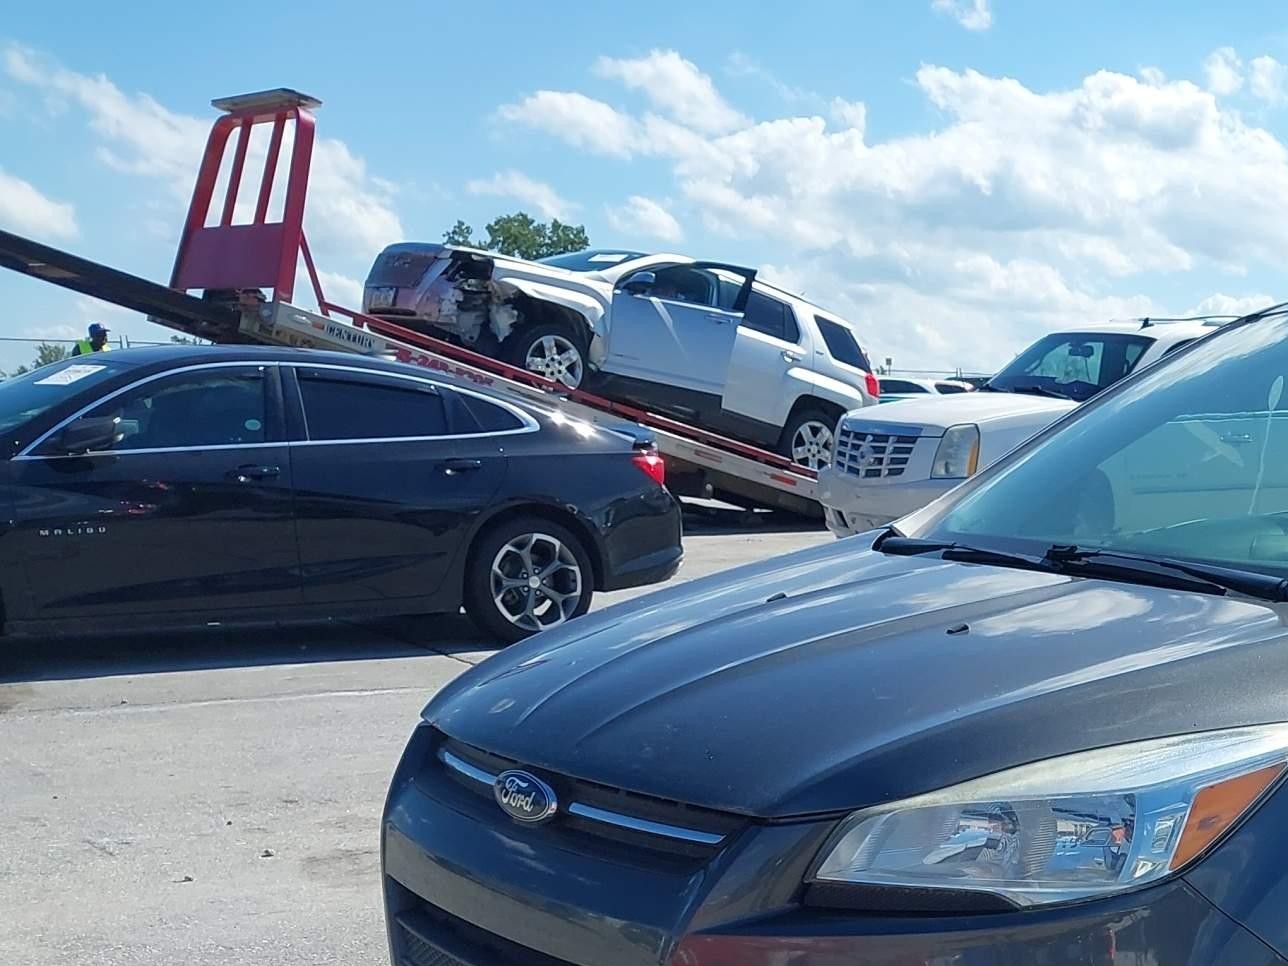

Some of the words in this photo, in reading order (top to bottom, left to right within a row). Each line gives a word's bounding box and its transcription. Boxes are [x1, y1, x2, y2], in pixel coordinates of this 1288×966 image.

[326, 323, 375, 349] CENTURY
[39, 527, 106, 536] MALIBU
[501, 776, 536, 812] Ford
